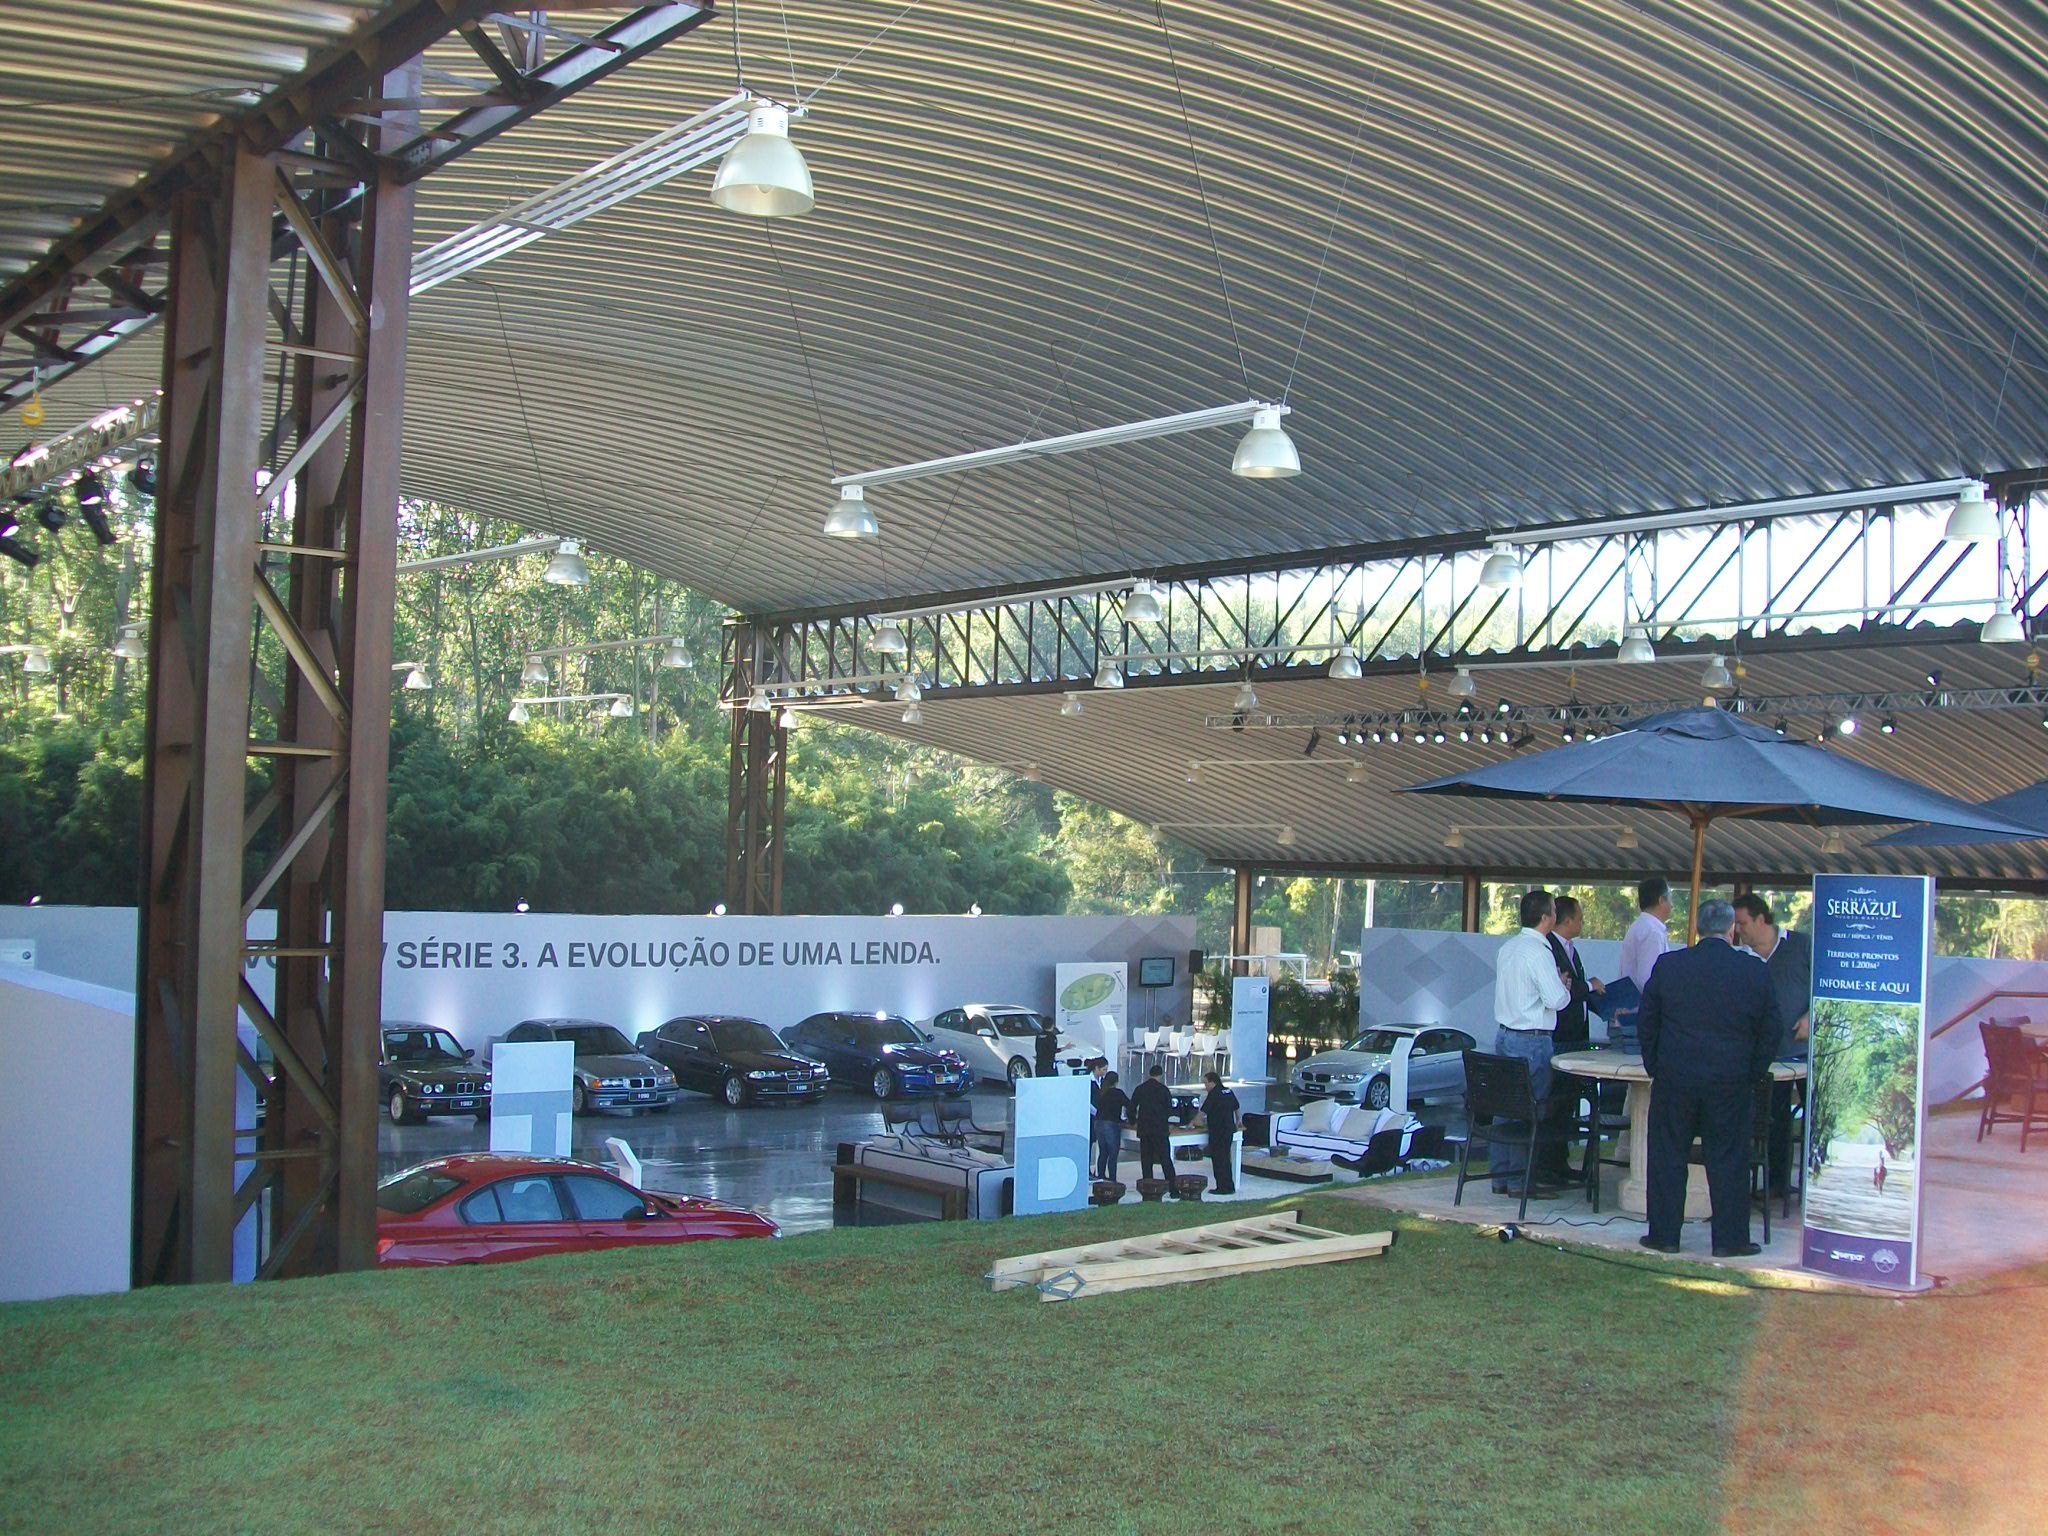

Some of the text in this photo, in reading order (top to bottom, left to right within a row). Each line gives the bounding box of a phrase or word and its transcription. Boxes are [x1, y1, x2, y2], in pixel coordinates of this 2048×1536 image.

[1827, 898, 1902, 919] SERRAZUL
[396, 936, 493, 969] SÉRIE
[502, 942, 528, 968] 3.
[537, 942, 559, 968] A
[568, 937, 730, 972] EVOLUÇÃO
[738, 942, 774, 967] DE
[783, 942, 843, 966] UMA
[850, 941, 941, 965] LENDA.
[1826, 949, 1900, 961] TERRENOS PRONTOS
[1840, 961, 1849, 969] DE
[1819, 978, 1910, 995] INFORME-SE AQUI
